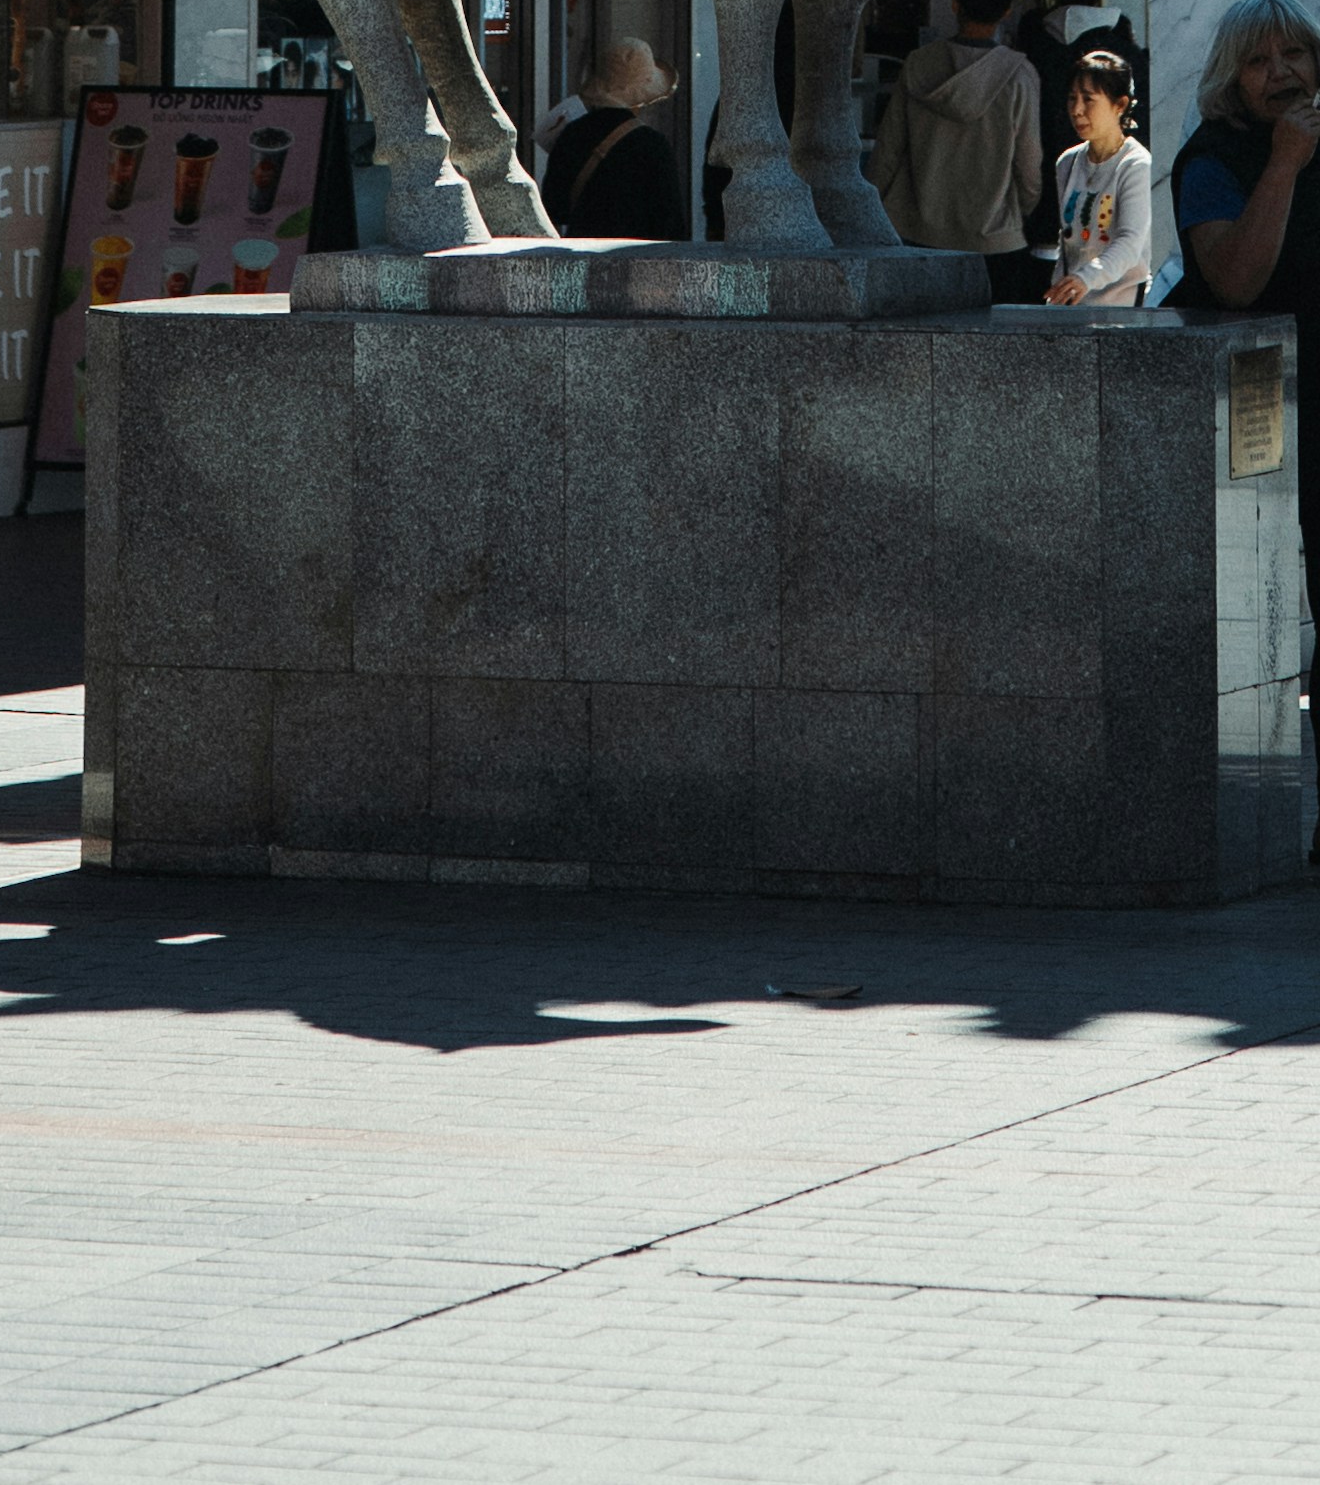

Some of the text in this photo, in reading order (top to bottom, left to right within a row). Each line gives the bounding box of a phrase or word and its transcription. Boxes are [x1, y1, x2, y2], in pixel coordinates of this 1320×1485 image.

[149, 94, 264, 113] TOP DRINKS
[25, 164, 50, 217] IT
[14, 247, 40, 298] IT
[2, 328, 29, 381] IT
